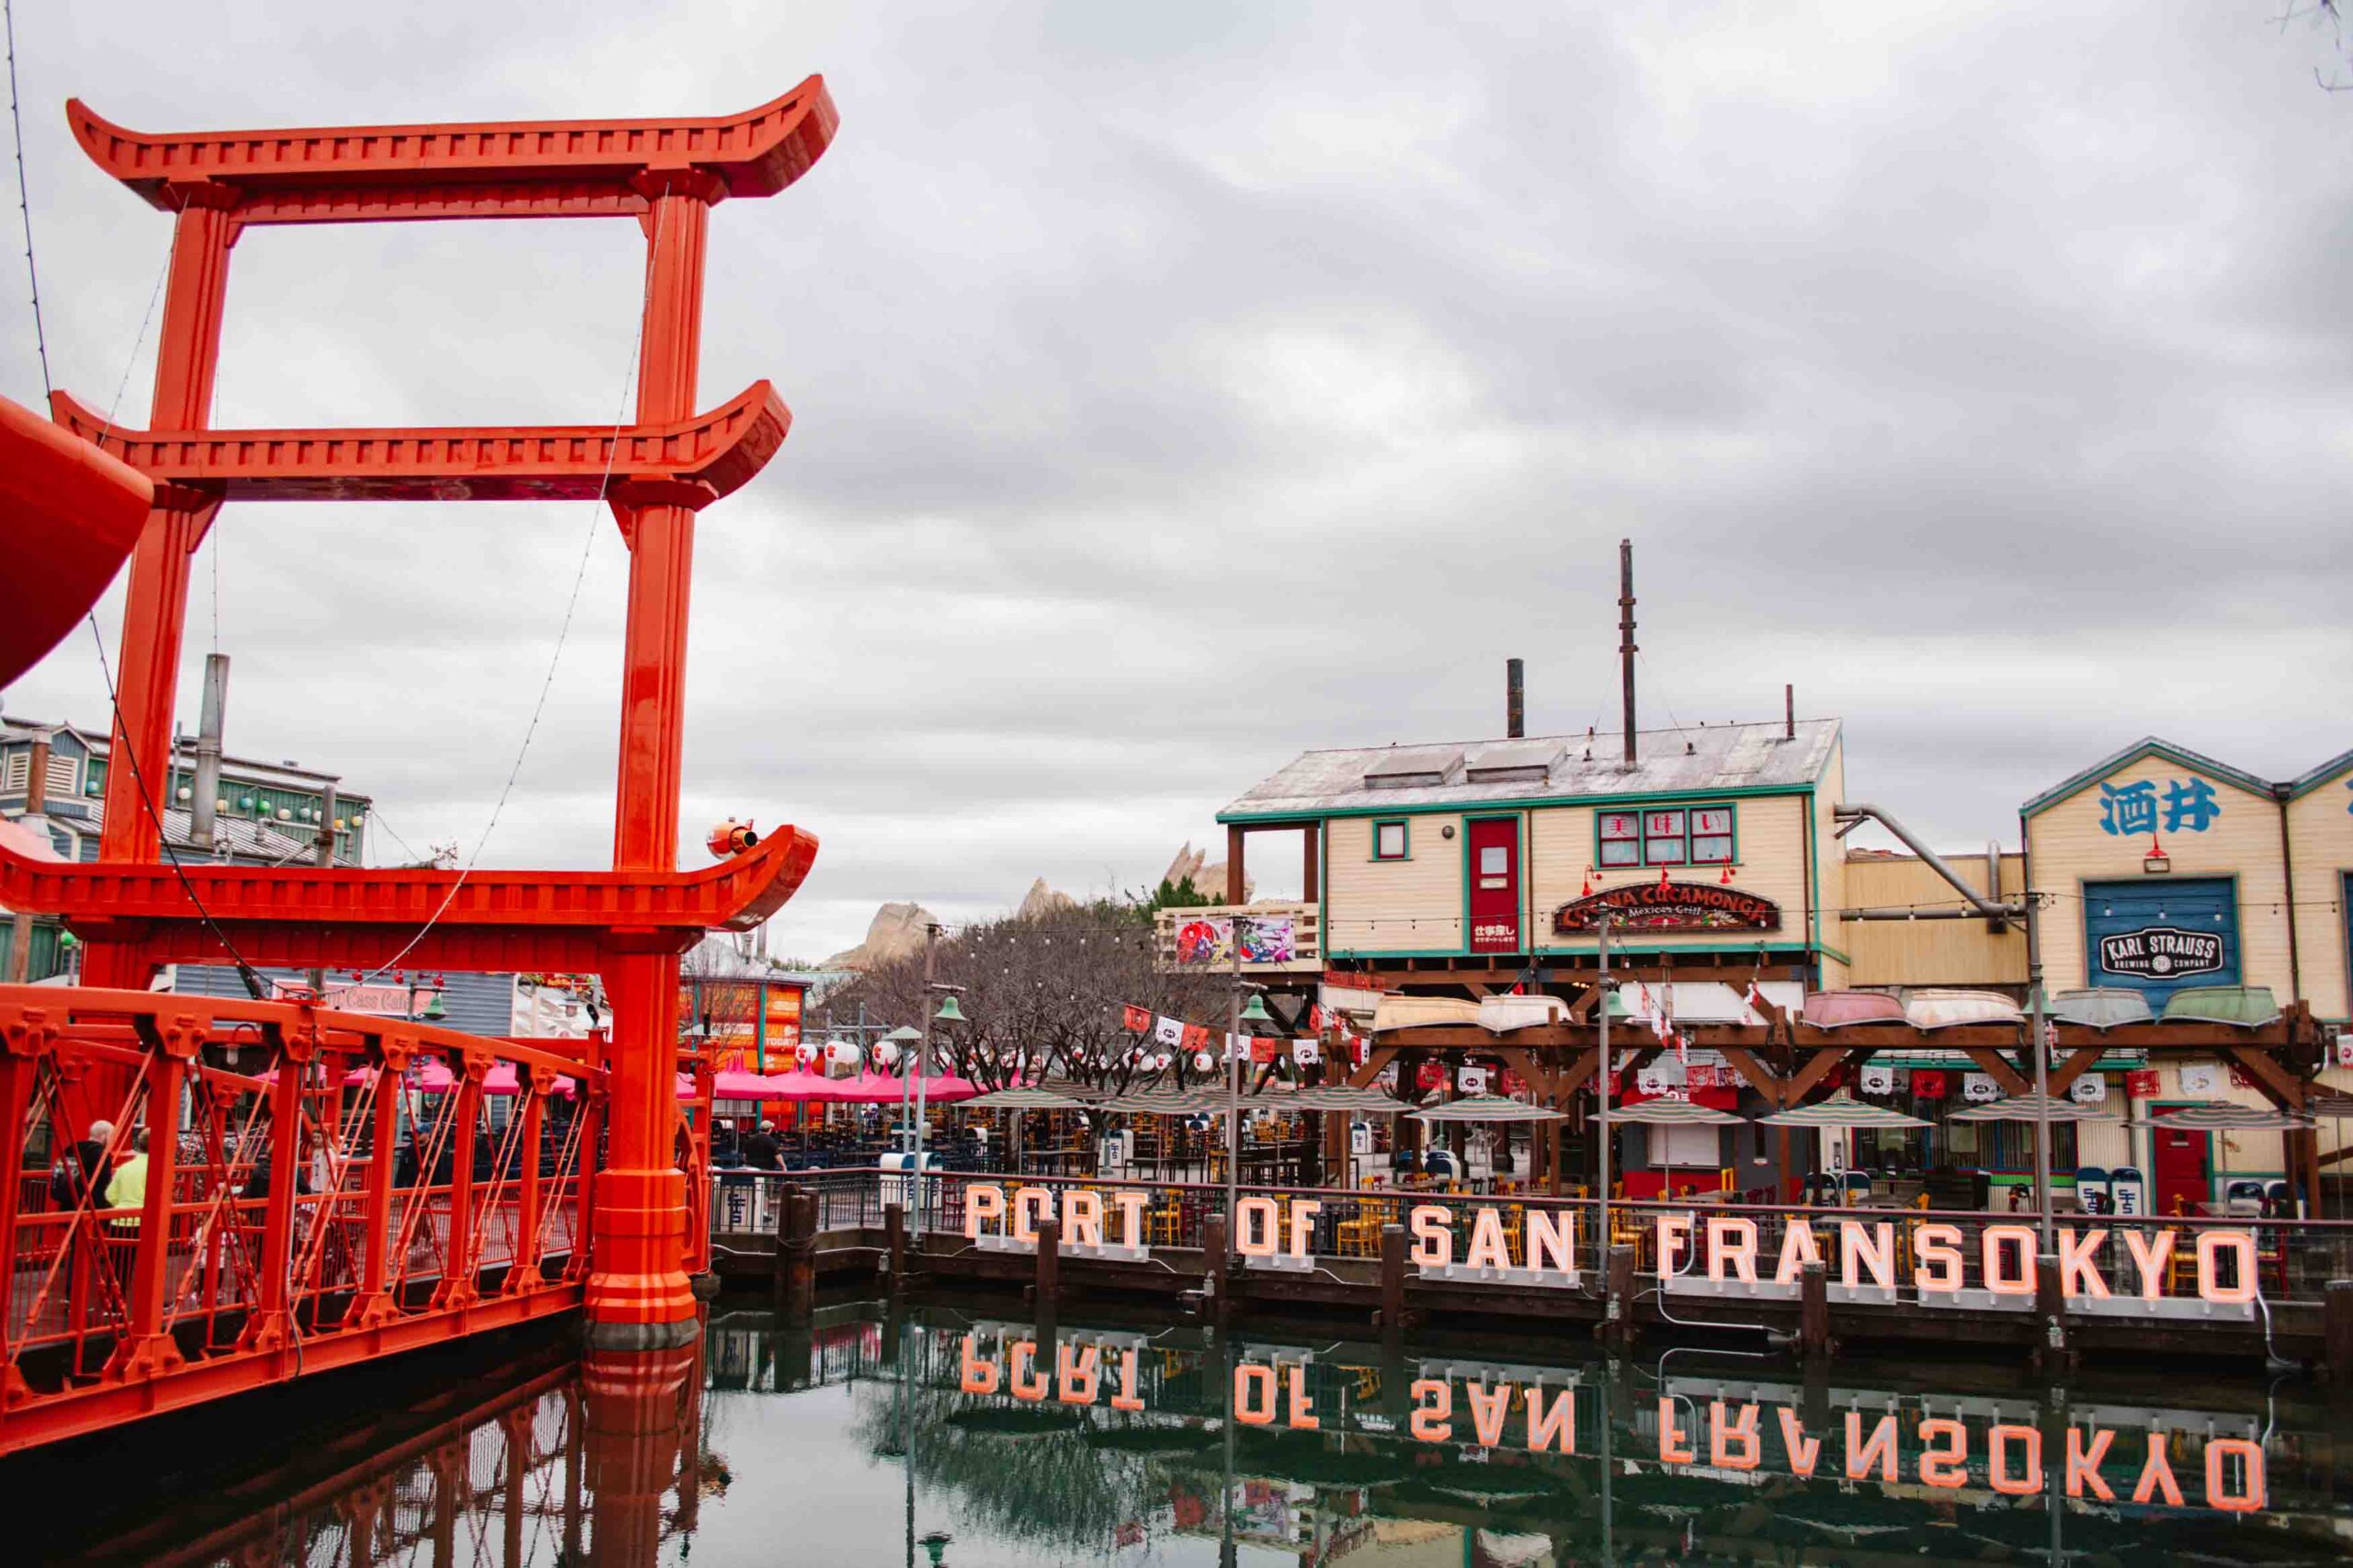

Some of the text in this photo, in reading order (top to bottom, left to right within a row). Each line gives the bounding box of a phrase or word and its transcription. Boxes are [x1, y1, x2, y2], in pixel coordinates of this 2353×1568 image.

[2098, 777, 2221, 836] 酒井
[1608, 813, 1722, 836] 美味い
[1628, 904, 1702, 918] Mexican Grill
[1641, 887, 1768, 924] CUCAMONGA
[2107, 935, 2216, 960] KARL STRAUSS
[2114, 960, 2150, 969] BREWING
[2174, 960, 2210, 968] COMPANY
[965, 1185, 2257, 1304] PORT OF SAN FRANSOKYO
